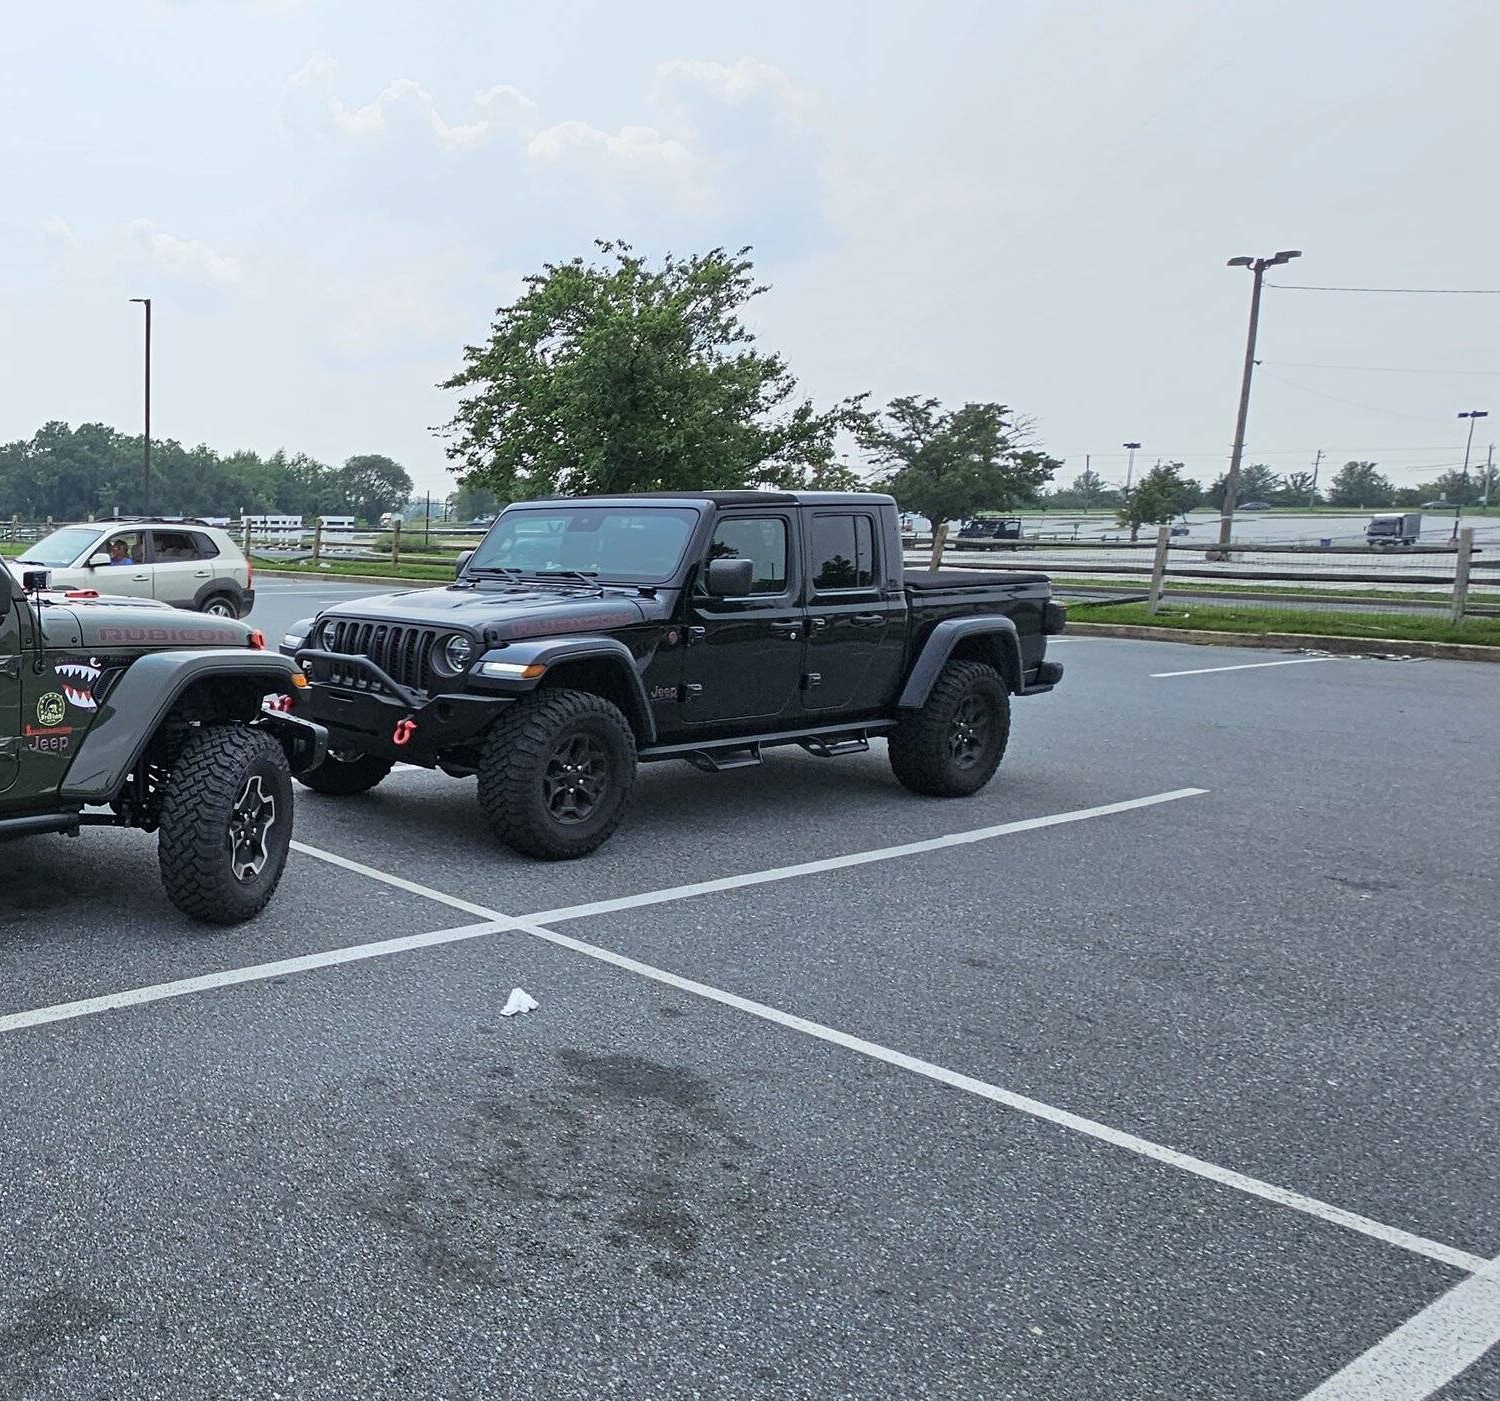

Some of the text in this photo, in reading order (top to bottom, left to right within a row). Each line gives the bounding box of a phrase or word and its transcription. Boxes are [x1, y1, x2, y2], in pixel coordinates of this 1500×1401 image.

[98, 627, 239, 642] RUBICON
[651, 685, 678, 698] Jeep
[28, 735, 69, 753] Jeep
